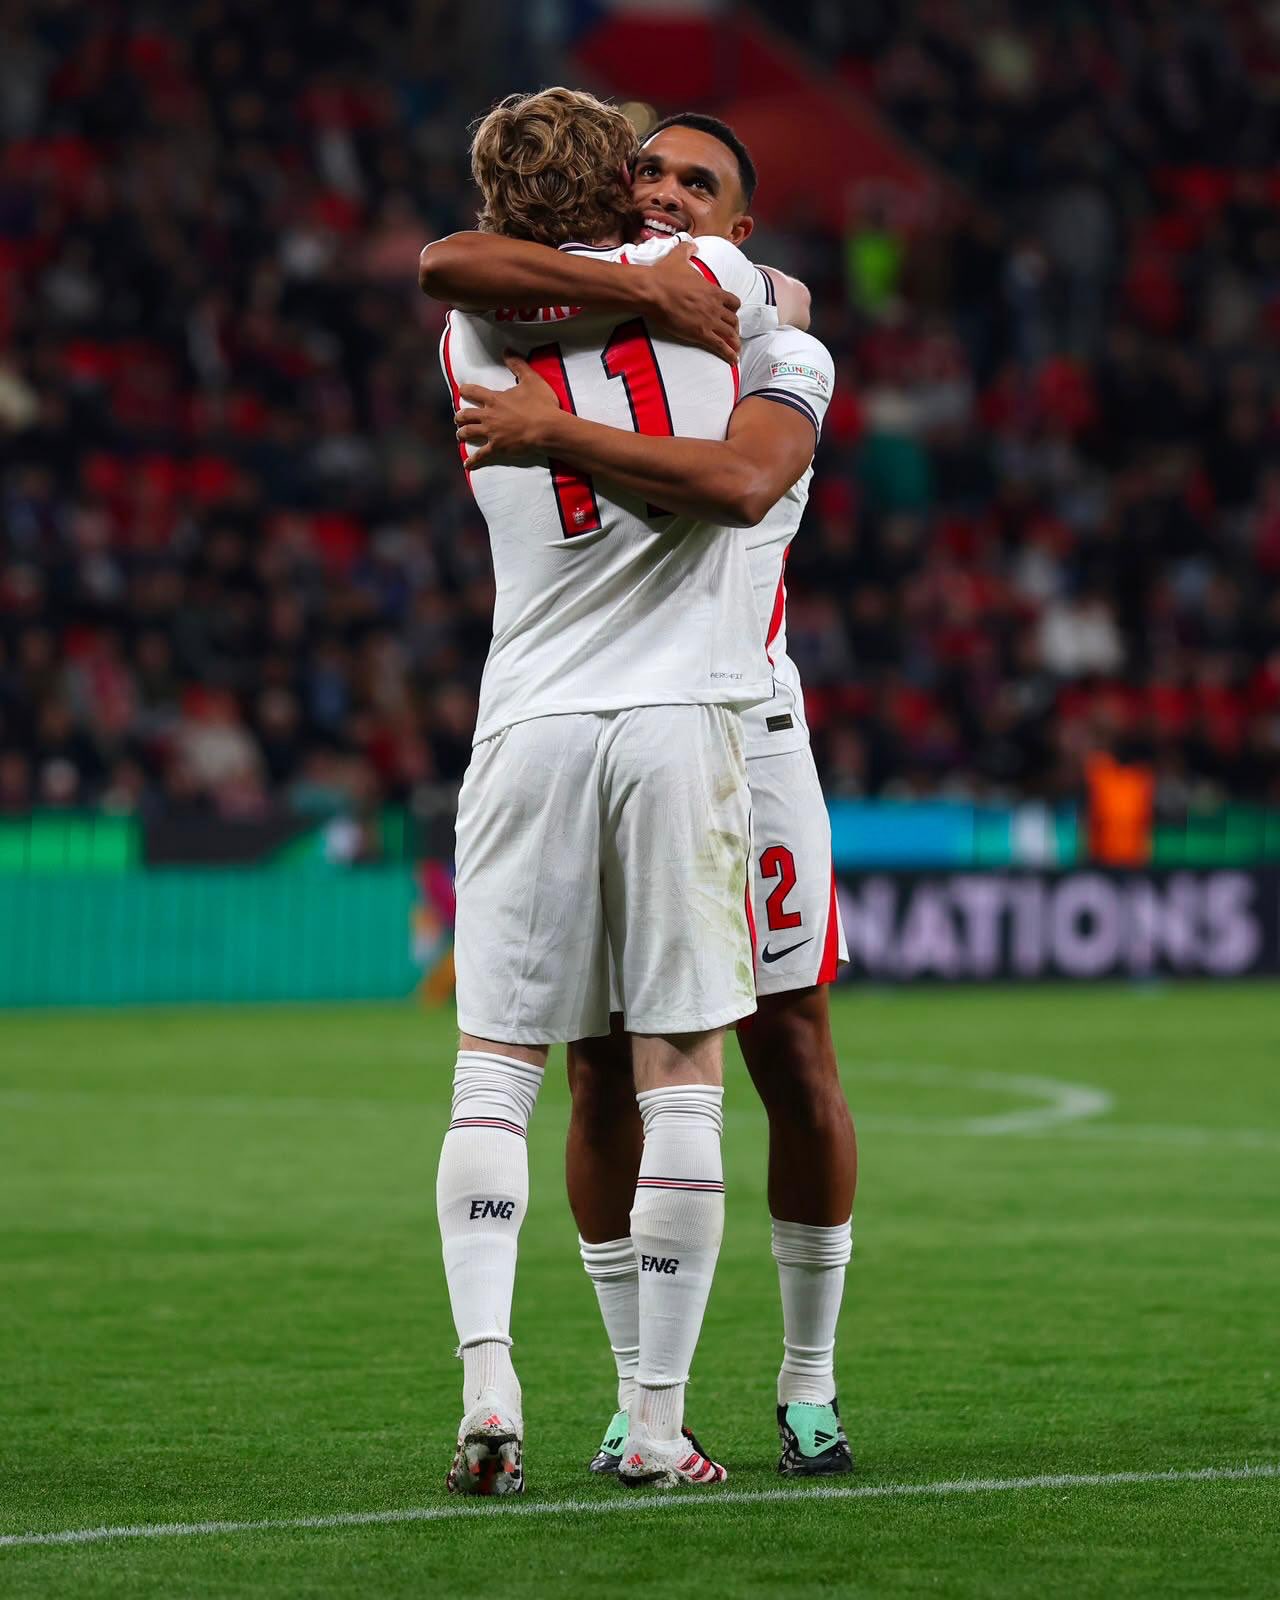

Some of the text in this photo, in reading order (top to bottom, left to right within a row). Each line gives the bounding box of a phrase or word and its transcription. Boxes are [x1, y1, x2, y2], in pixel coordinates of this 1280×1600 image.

[516, 317, 675, 539] 11
[759, 845, 802, 931] 2
[838, 872, 1261, 977] NATIONS
[469, 1200, 516, 1220] ENG
[641, 1255, 680, 1275] ENG
